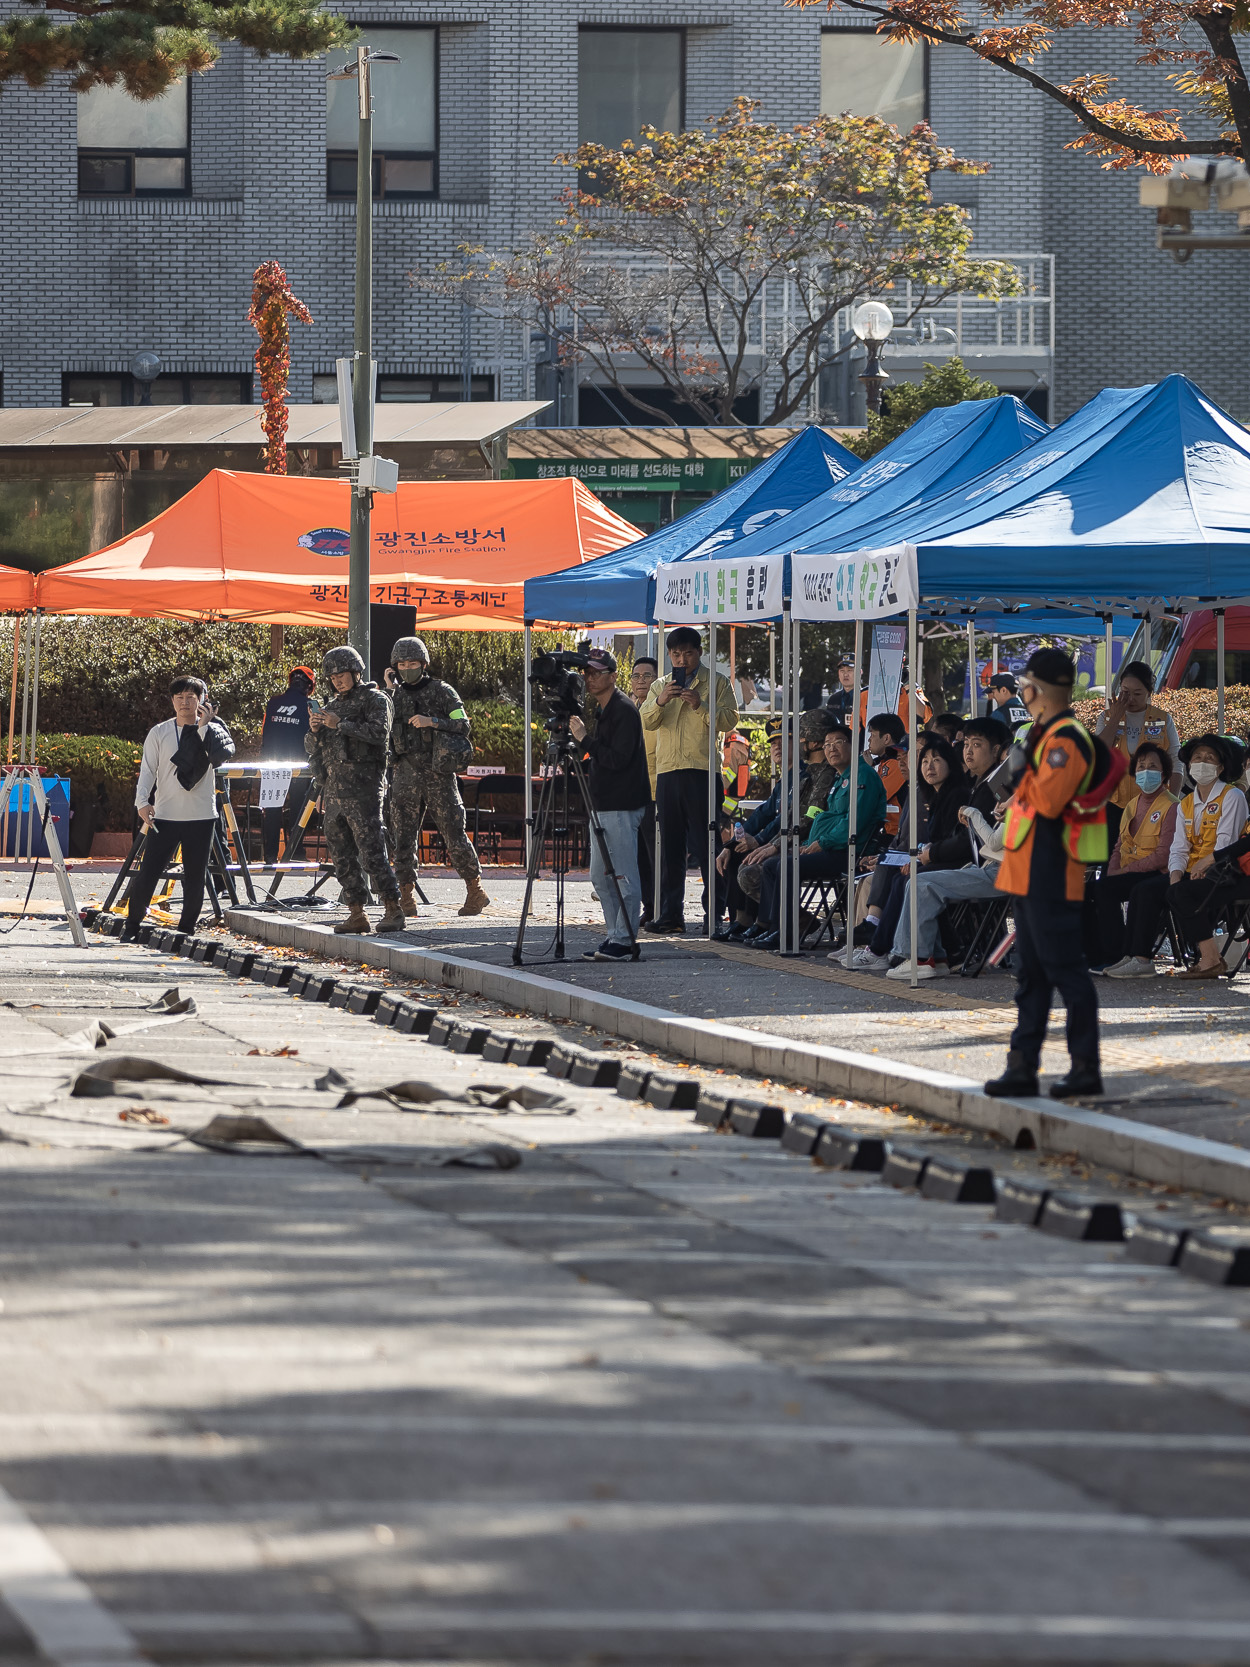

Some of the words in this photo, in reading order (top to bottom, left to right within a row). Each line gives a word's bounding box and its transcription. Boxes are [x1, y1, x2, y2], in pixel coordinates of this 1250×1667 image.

[537, 464, 566, 478] 창조적
[569, 464, 607, 478] 혁신으로
[610, 463, 639, 478] 미래를
[643, 463, 681, 478] 선도하는
[684, 463, 704, 477] 대학
[729, 465, 748, 477] KU
[374, 527, 506, 548] 광진소방서
[375, 585, 509, 608] 긴급구조통제단
[694, 570, 709, 614] 안전
[717, 568, 738, 613] 한국
[746, 564, 768, 611] 훈련
[836, 562, 856, 611] 안전
[859, 561, 879, 610] 한국
[277, 705, 298, 715] 119
